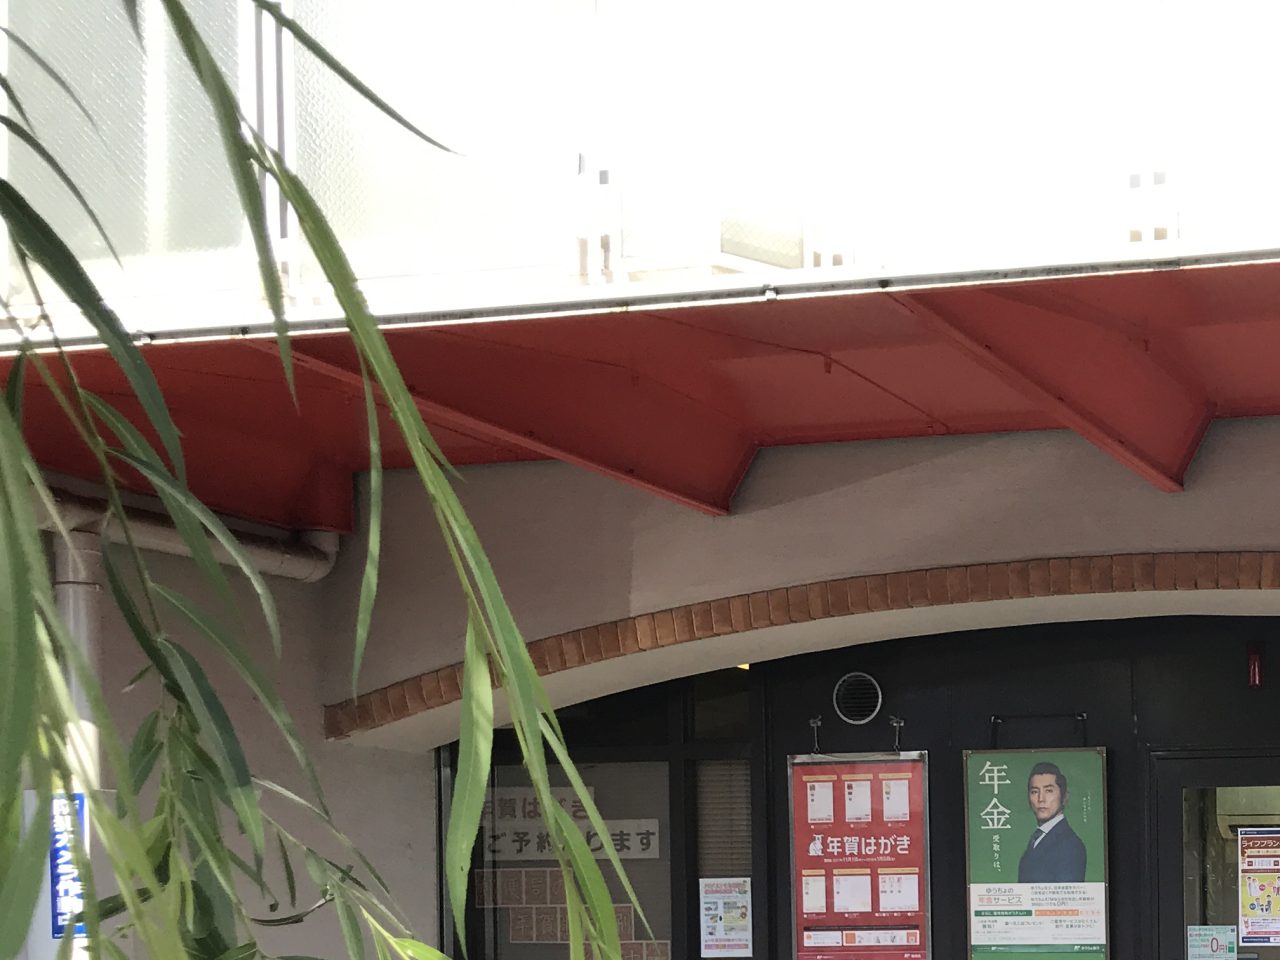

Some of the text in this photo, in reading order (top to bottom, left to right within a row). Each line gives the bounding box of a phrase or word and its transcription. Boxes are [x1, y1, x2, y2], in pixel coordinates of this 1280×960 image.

[979, 761, 1011, 829] 年金
[488, 830, 656, 853] ご予約ります
[827, 834, 911, 855] 年賀はがき
